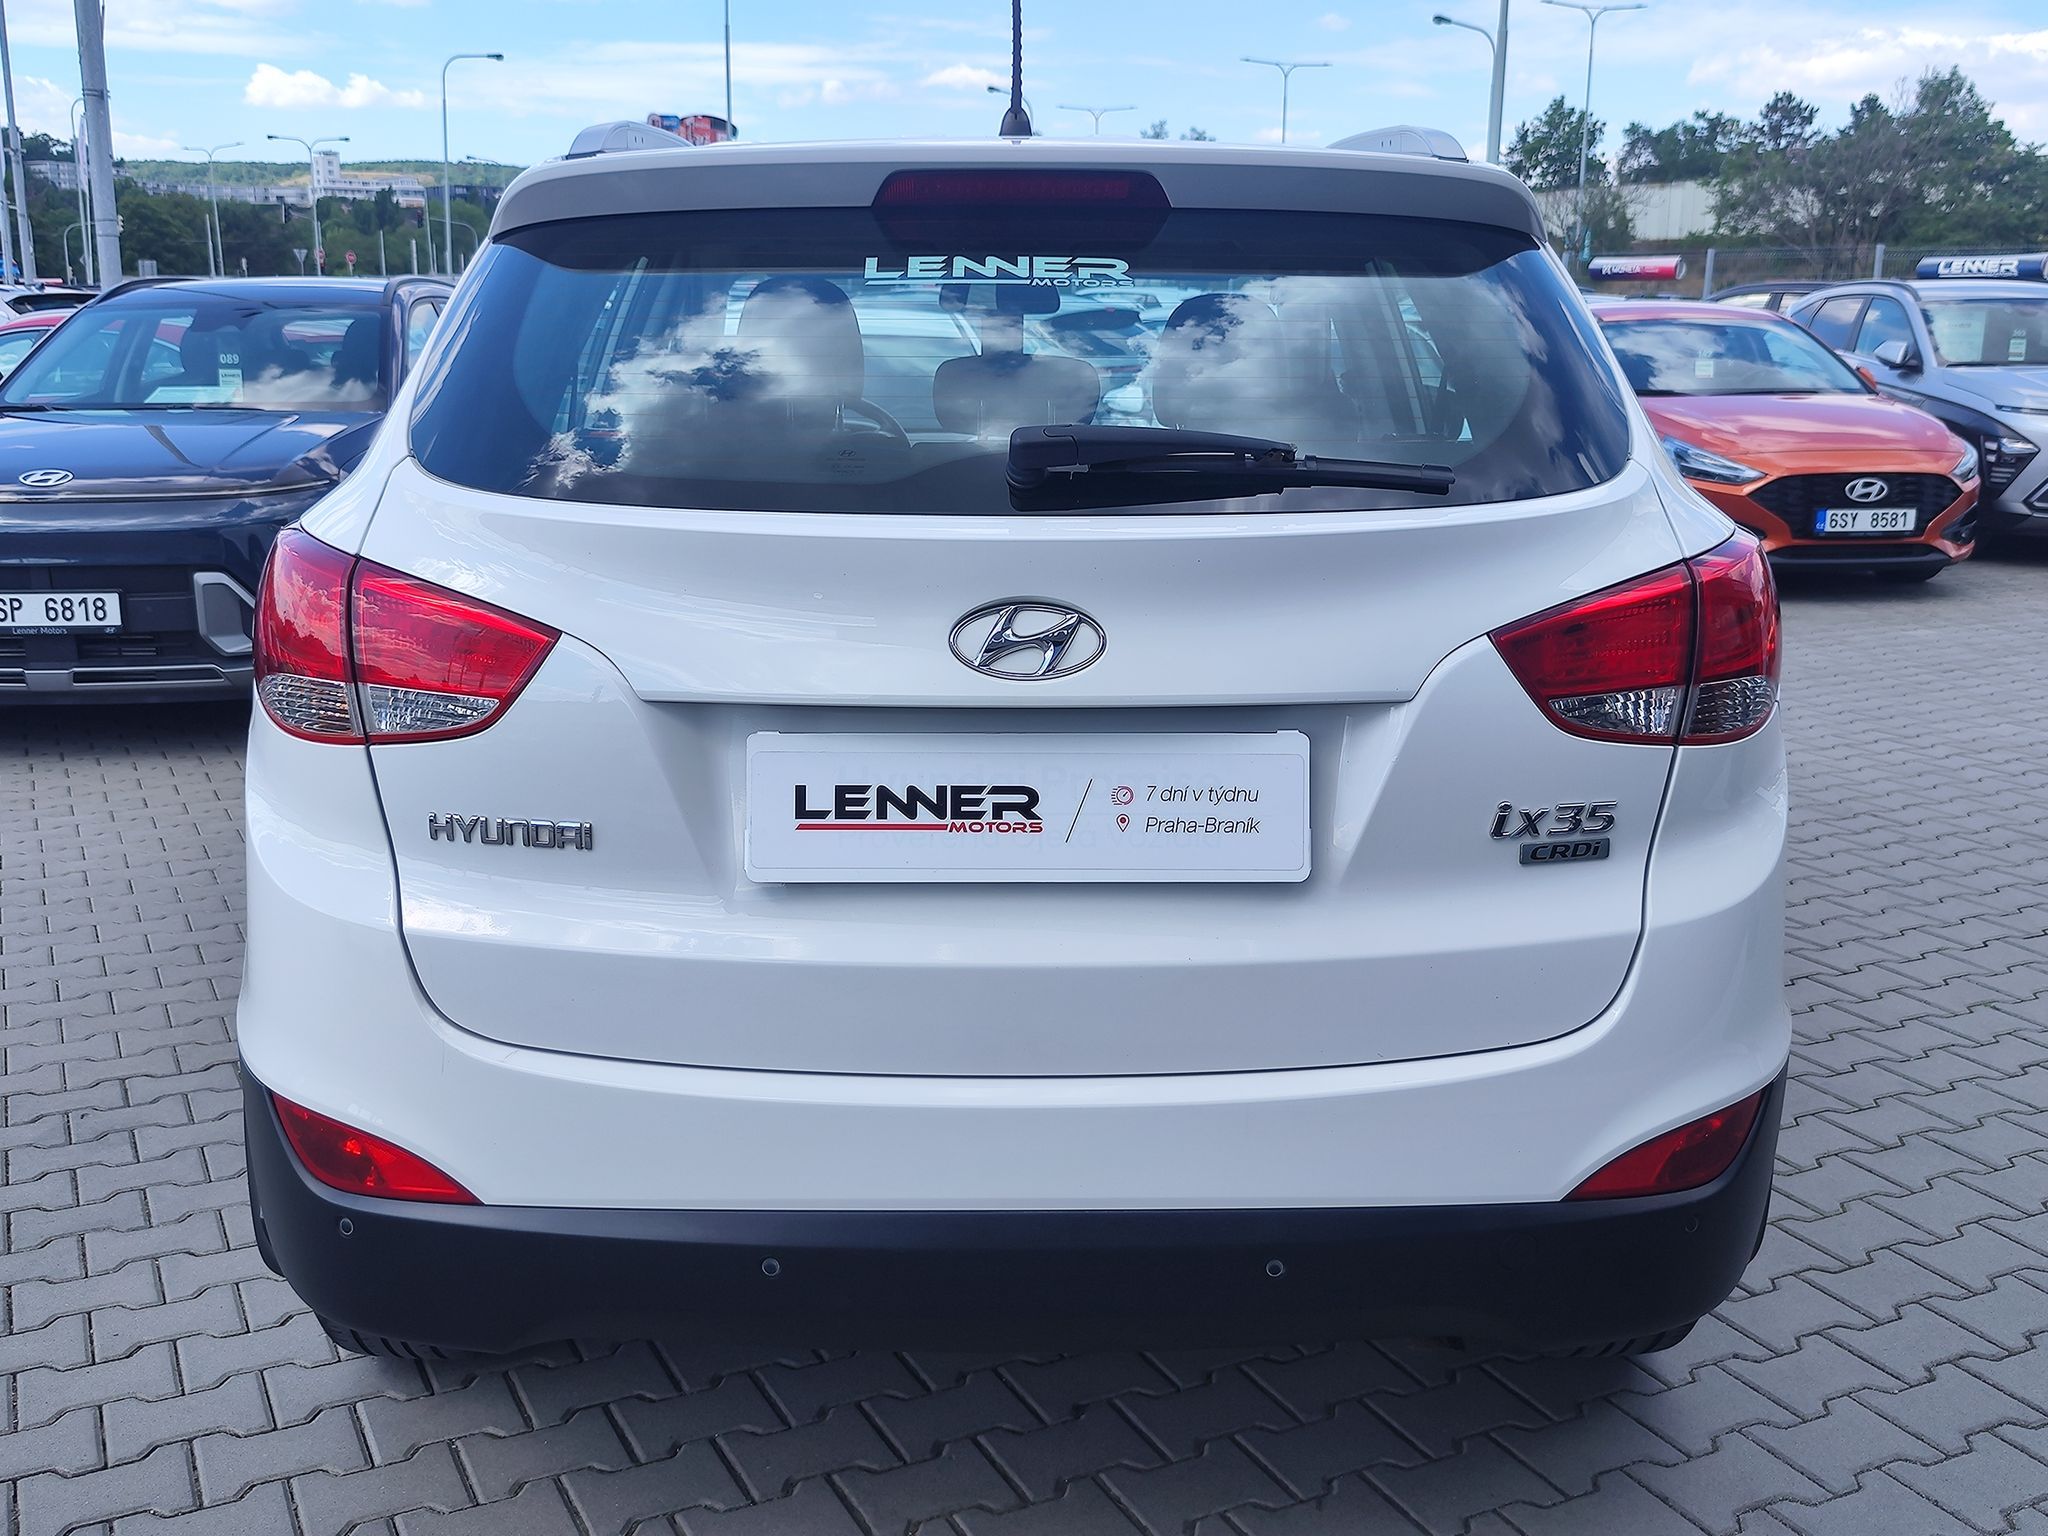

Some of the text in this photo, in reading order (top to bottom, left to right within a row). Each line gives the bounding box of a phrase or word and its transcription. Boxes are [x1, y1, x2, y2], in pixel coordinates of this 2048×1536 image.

[864, 256, 1133, 281] LENNER
[1938, 259, 2018, 274] LENNER
[1031, 279, 1135, 287] MOTORS
[220, 353, 240, 364] 089
[1829, 511, 1858, 528] 6SY
[1870, 511, 1907, 528] 8581
[44, 597, 107, 621] 6818
[795, 784, 1043, 820] LENNER
[1146, 785, 1259, 806] 7 dní v týdnu
[948, 821, 1043, 834] MOTORS
[1145, 816, 1261, 834] Praha-Braník
[1490, 800, 1618, 840] ix35
[427, 811, 593, 850] HYUNDAI
[1529, 841, 1601, 860] CRDi
